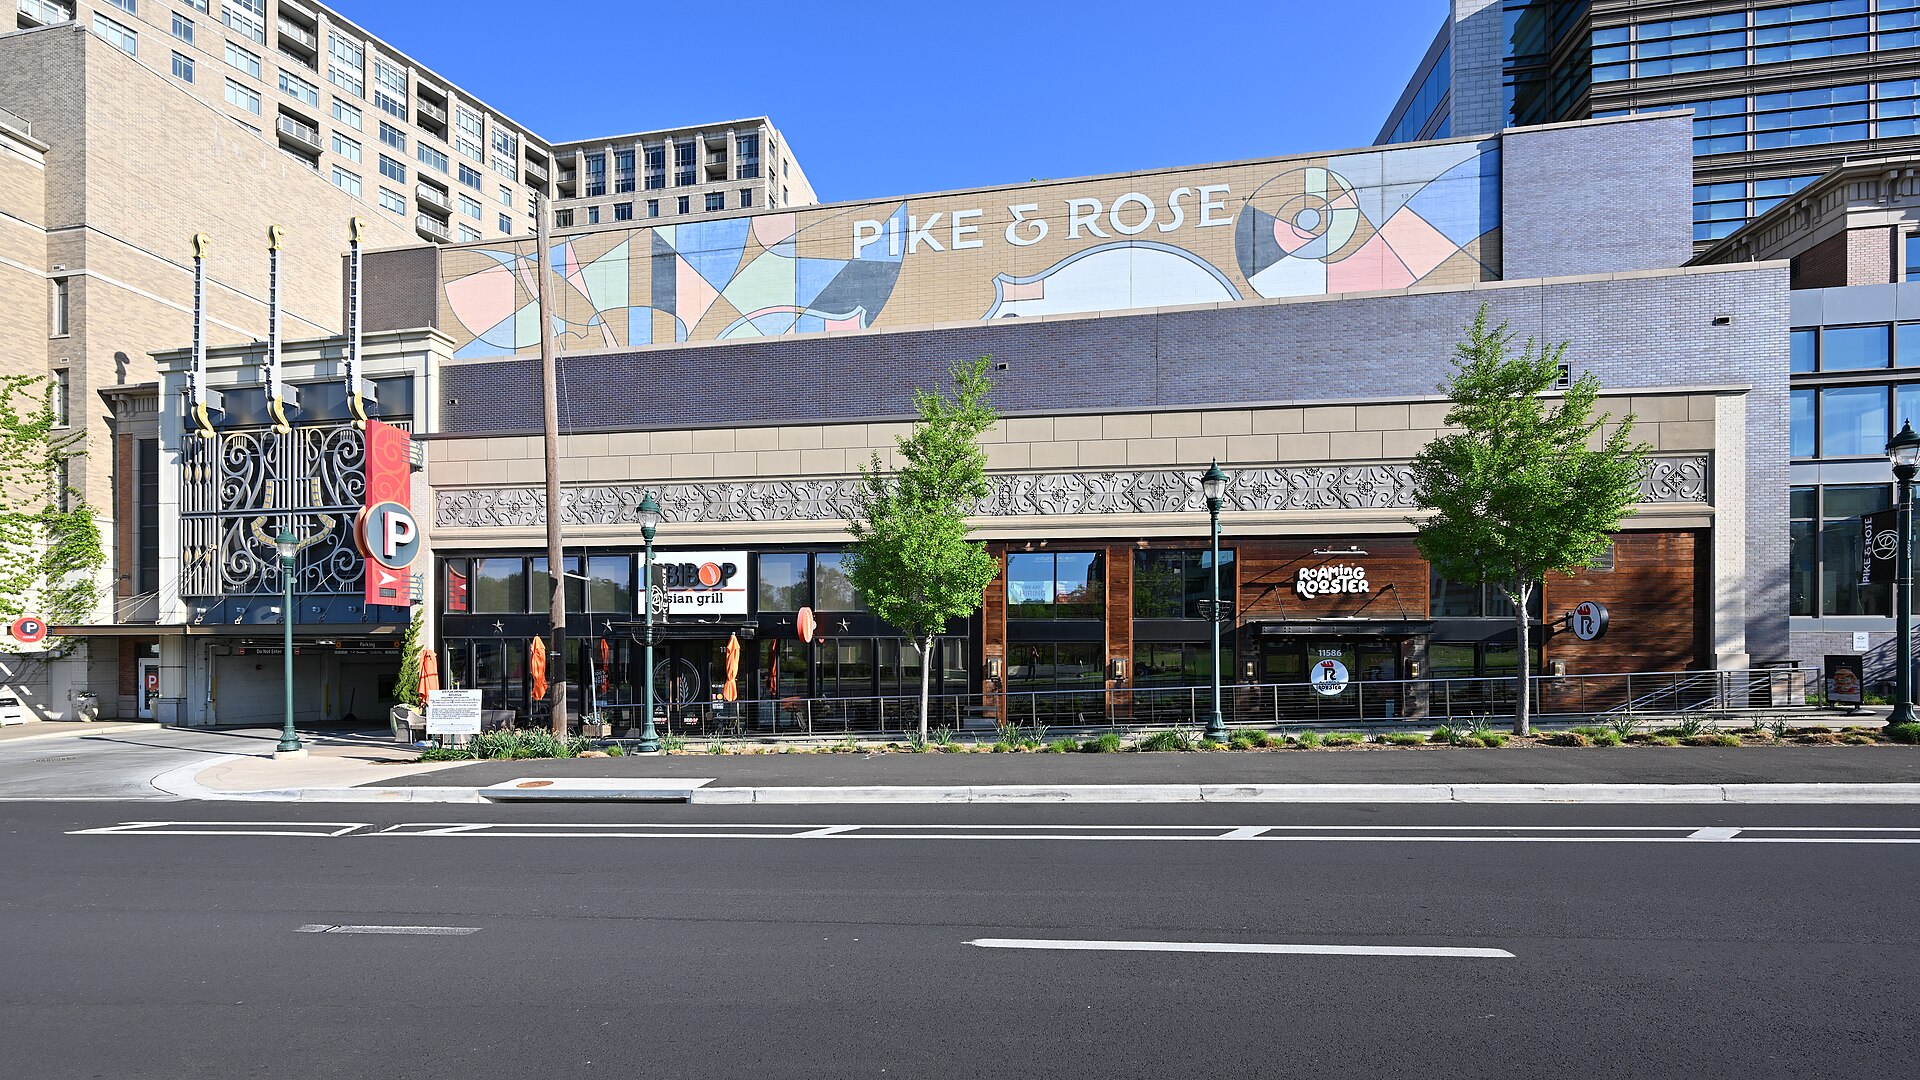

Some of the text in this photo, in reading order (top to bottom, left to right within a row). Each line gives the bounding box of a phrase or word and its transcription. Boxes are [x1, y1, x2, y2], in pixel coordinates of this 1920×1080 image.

[853, 183, 1235, 259] PIKE & ROSE
[382, 510, 416, 557] P
[1862, 516, 1873, 583] PIKE & ROSE
[1296, 576, 1370, 599] ROOSTER
[667, 592, 724, 606] sian grill
[26, 622, 38, 633] P
[359, 641, 376, 649] Parking
[1318, 649, 1342, 657] 11586
[148, 674, 157, 689] P
